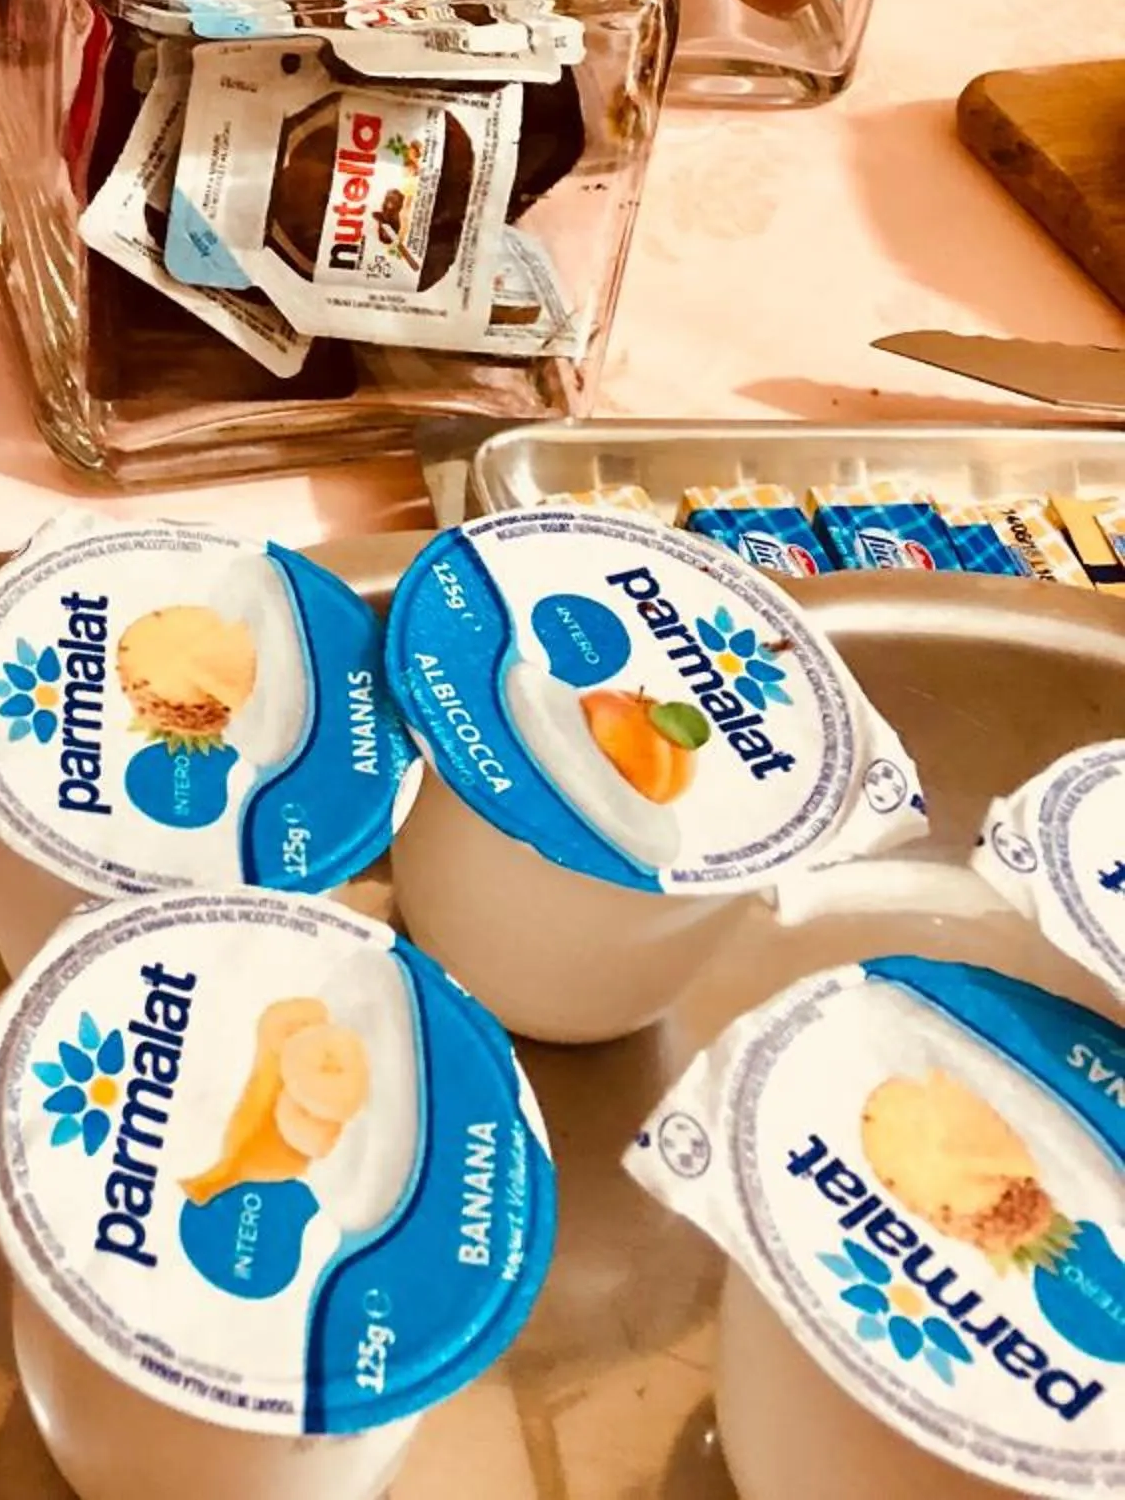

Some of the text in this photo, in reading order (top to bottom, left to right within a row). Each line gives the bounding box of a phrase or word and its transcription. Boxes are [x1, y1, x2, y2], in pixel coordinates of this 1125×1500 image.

[328, 112, 383, 272] nutella
[430, 562, 464, 614] 125g
[556, 606, 600, 666] INTERO
[58, 591, 112, 815] parmalat
[607, 566, 796, 781] parmalat
[347, 670, 379, 776] ANANAS
[415, 652, 513, 795] ALBICOCCA
[174, 755, 191, 816] INTERO
[284, 828, 311, 878] 125g
[95, 962, 197, 1268] parmalat
[1067, 1044, 1125, 1109] NAS
[234, 1192, 264, 1281] INTERO
[458, 1120, 498, 1267] BANANA
[788, 1134, 1106, 1422] parmalat
[1061, 1264, 1125, 1324] TERO
[356, 1320, 397, 1395] 125g
